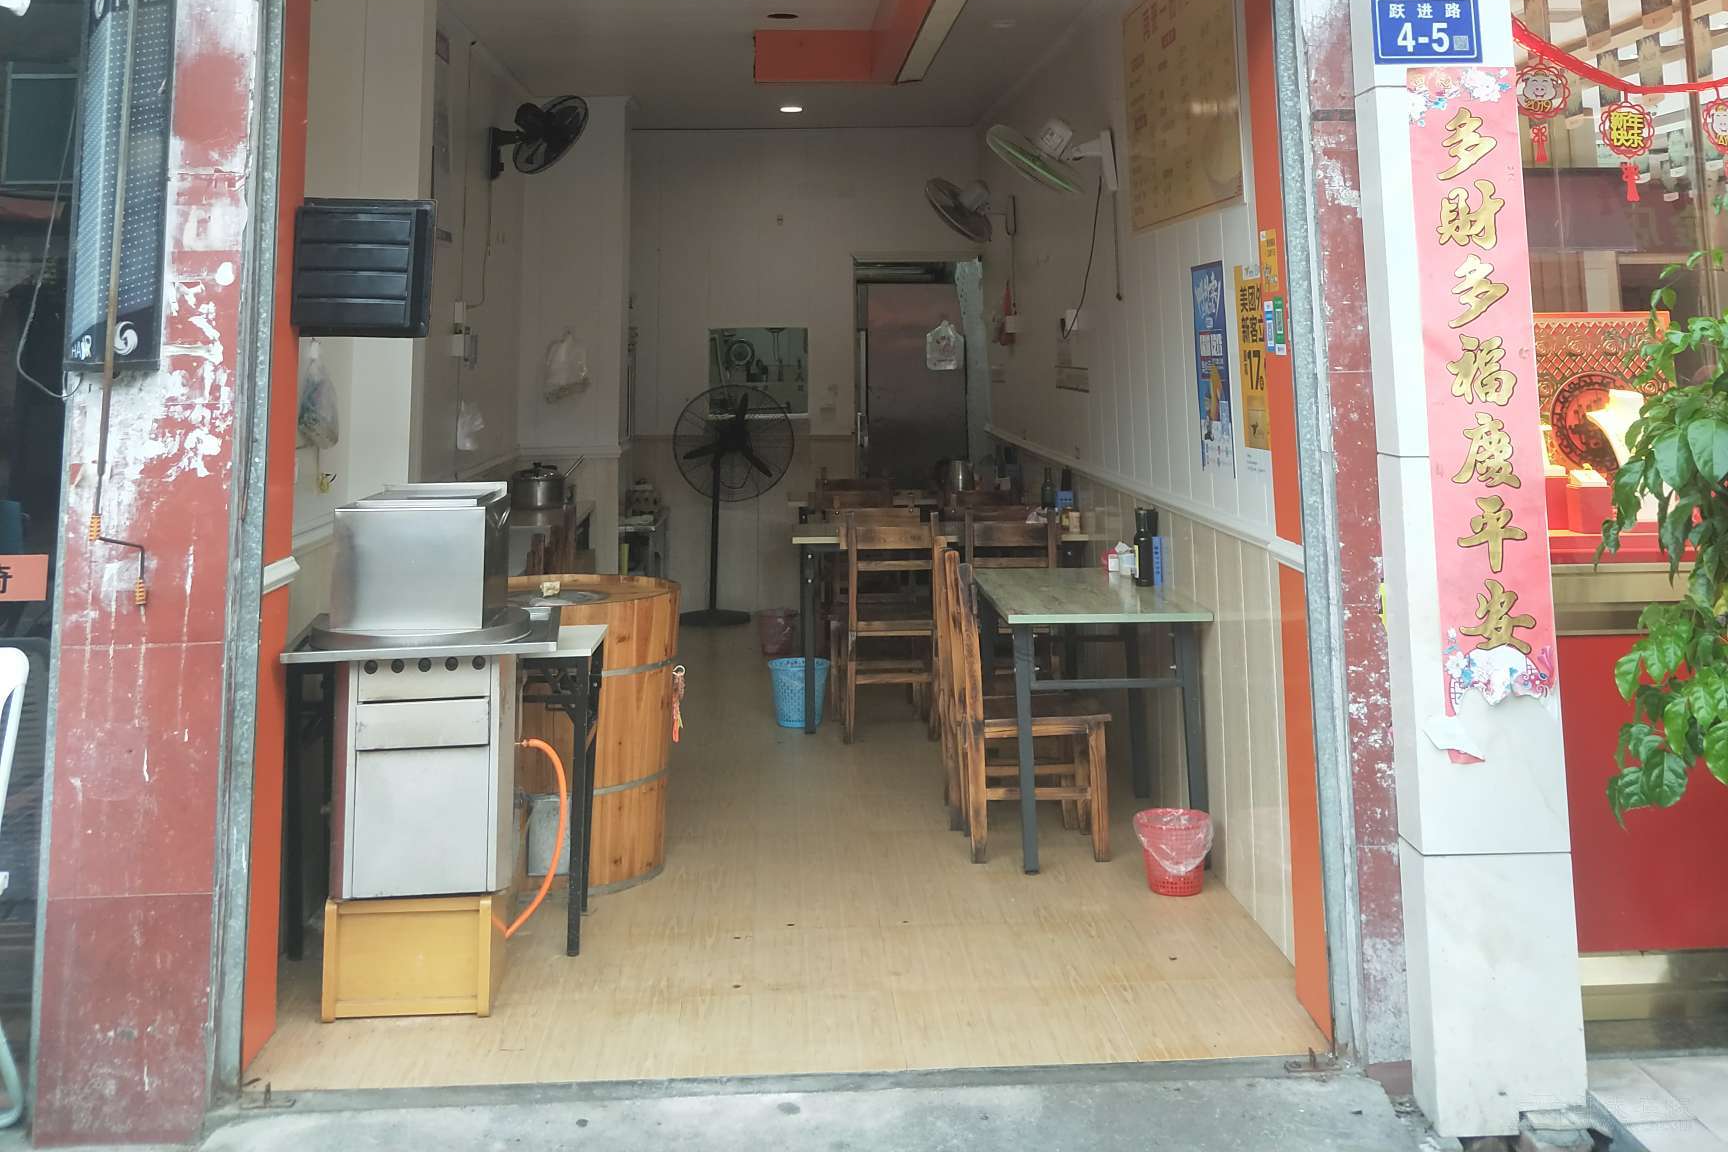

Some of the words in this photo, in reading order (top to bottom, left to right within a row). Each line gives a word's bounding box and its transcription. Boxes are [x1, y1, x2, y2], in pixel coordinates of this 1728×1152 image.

[1388, 3, 1461, 19] 跃进路
[1397, 22, 1450, 53] 4-5
[1525, 99, 1553, 113] 2019
